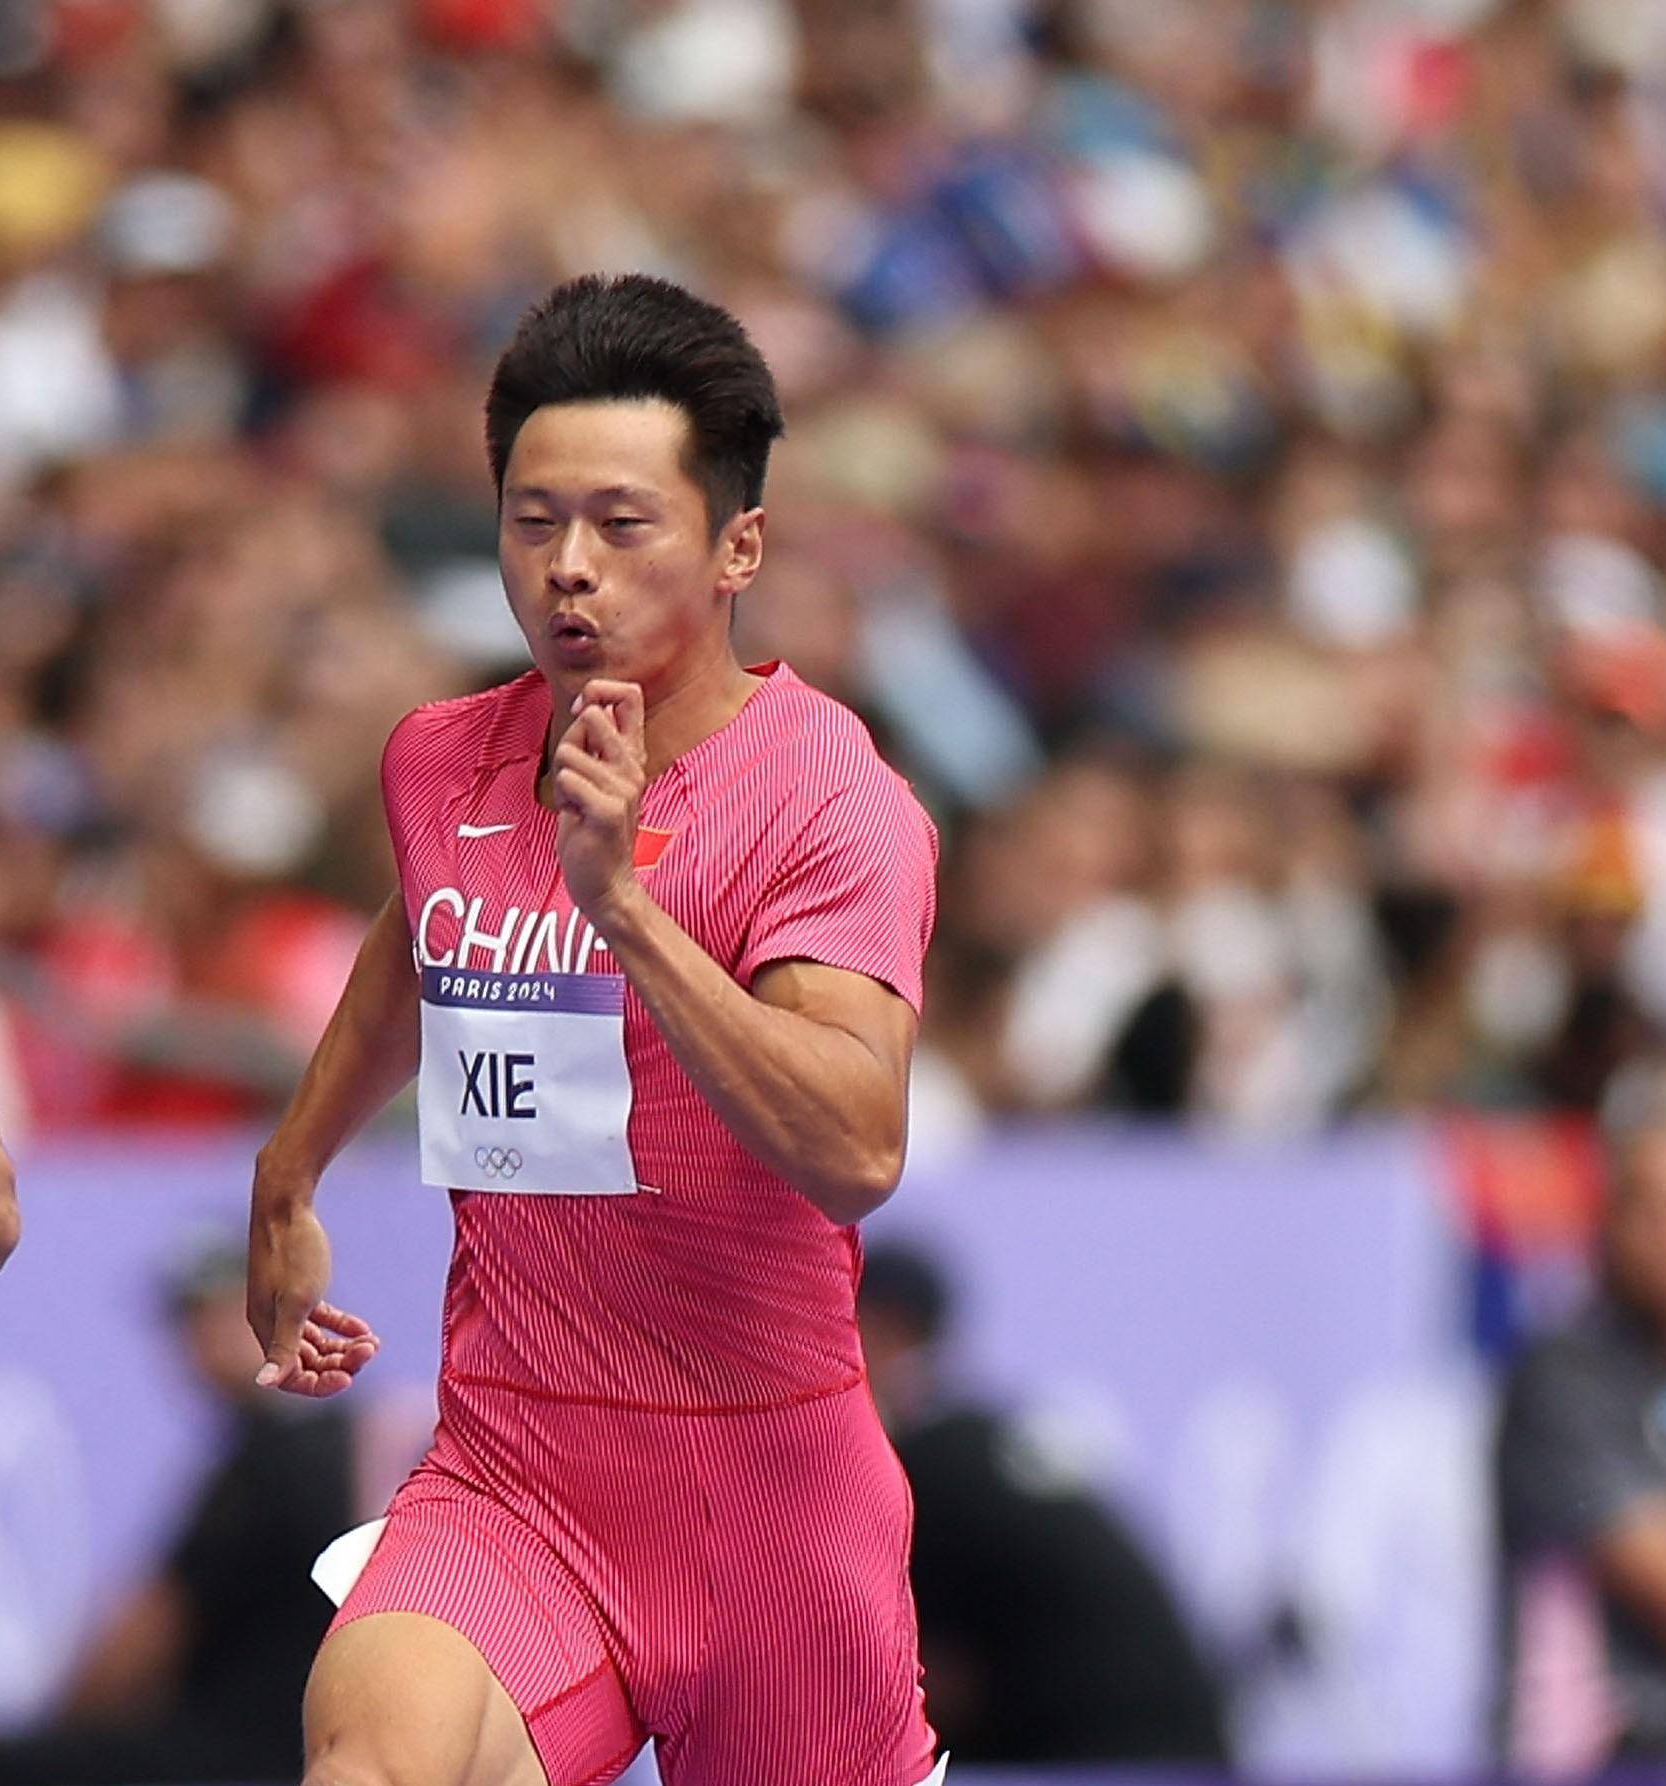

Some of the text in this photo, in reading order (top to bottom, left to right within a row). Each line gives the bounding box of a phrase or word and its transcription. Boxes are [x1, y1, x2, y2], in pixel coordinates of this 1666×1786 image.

[439, 975, 556, 1002] PARIS 2024
[458, 1050, 537, 1118] XIE
